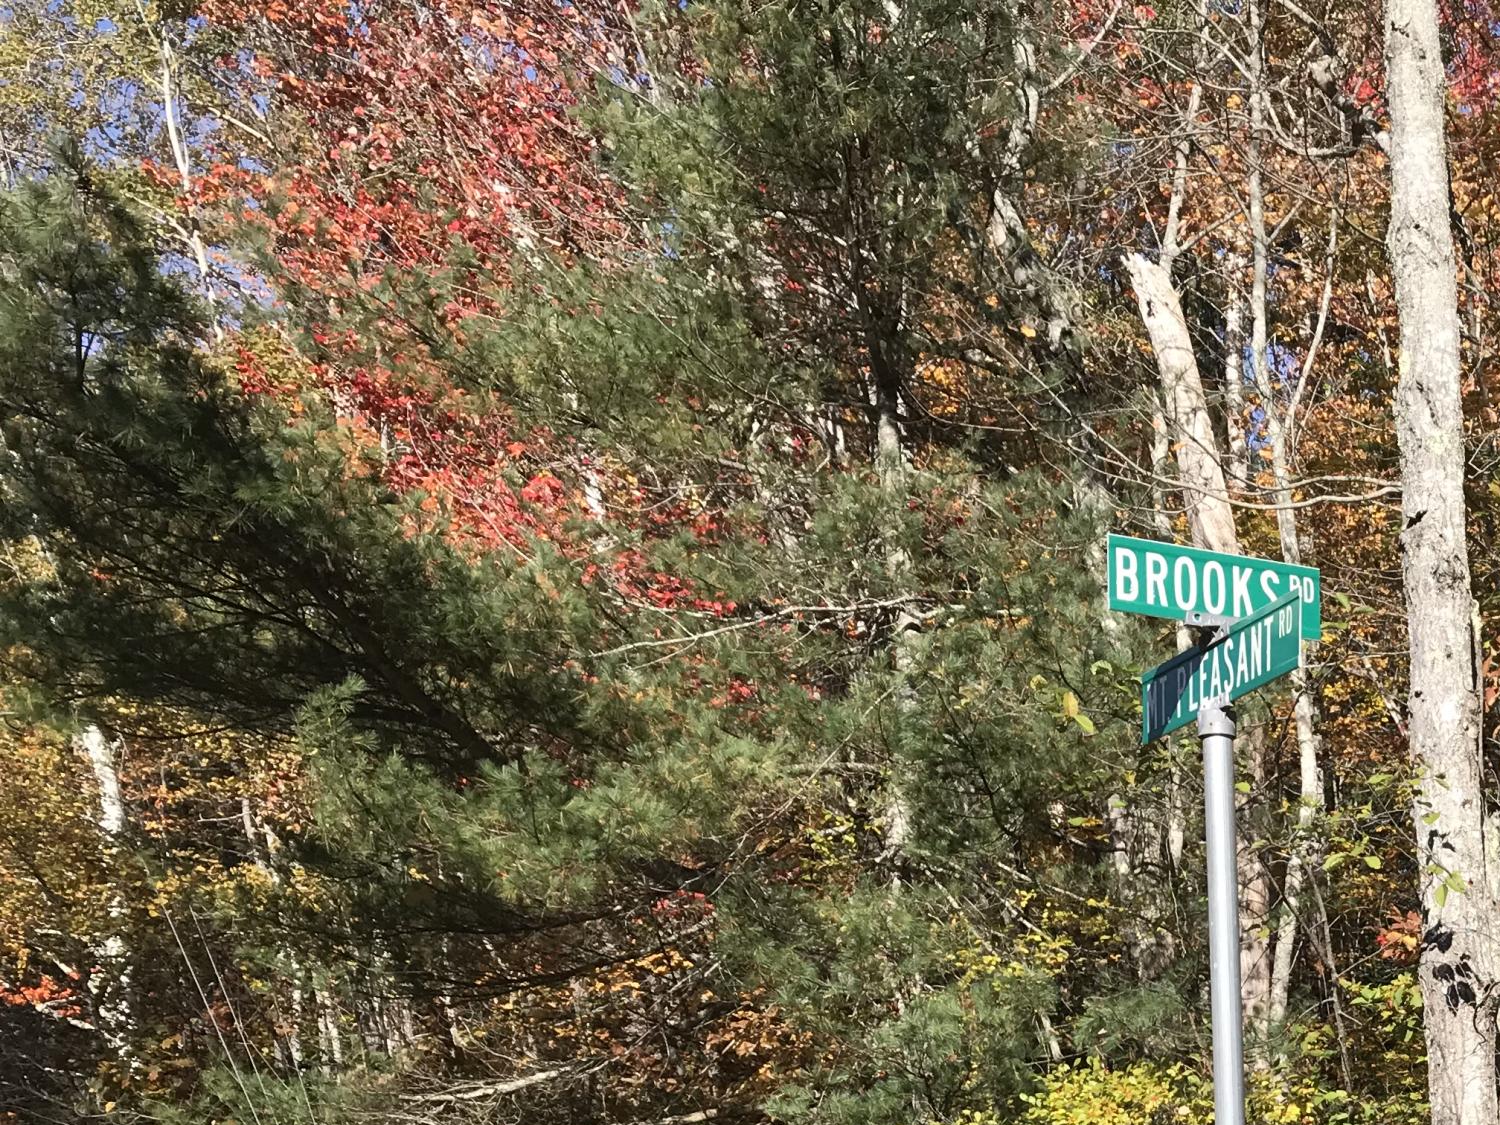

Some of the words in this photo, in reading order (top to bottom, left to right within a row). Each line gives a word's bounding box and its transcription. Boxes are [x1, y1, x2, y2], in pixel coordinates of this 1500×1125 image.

[1115, 546, 1280, 618] BROOKS
[1176, 615, 1274, 718] PLEASANT
[1278, 604, 1293, 638] RD
